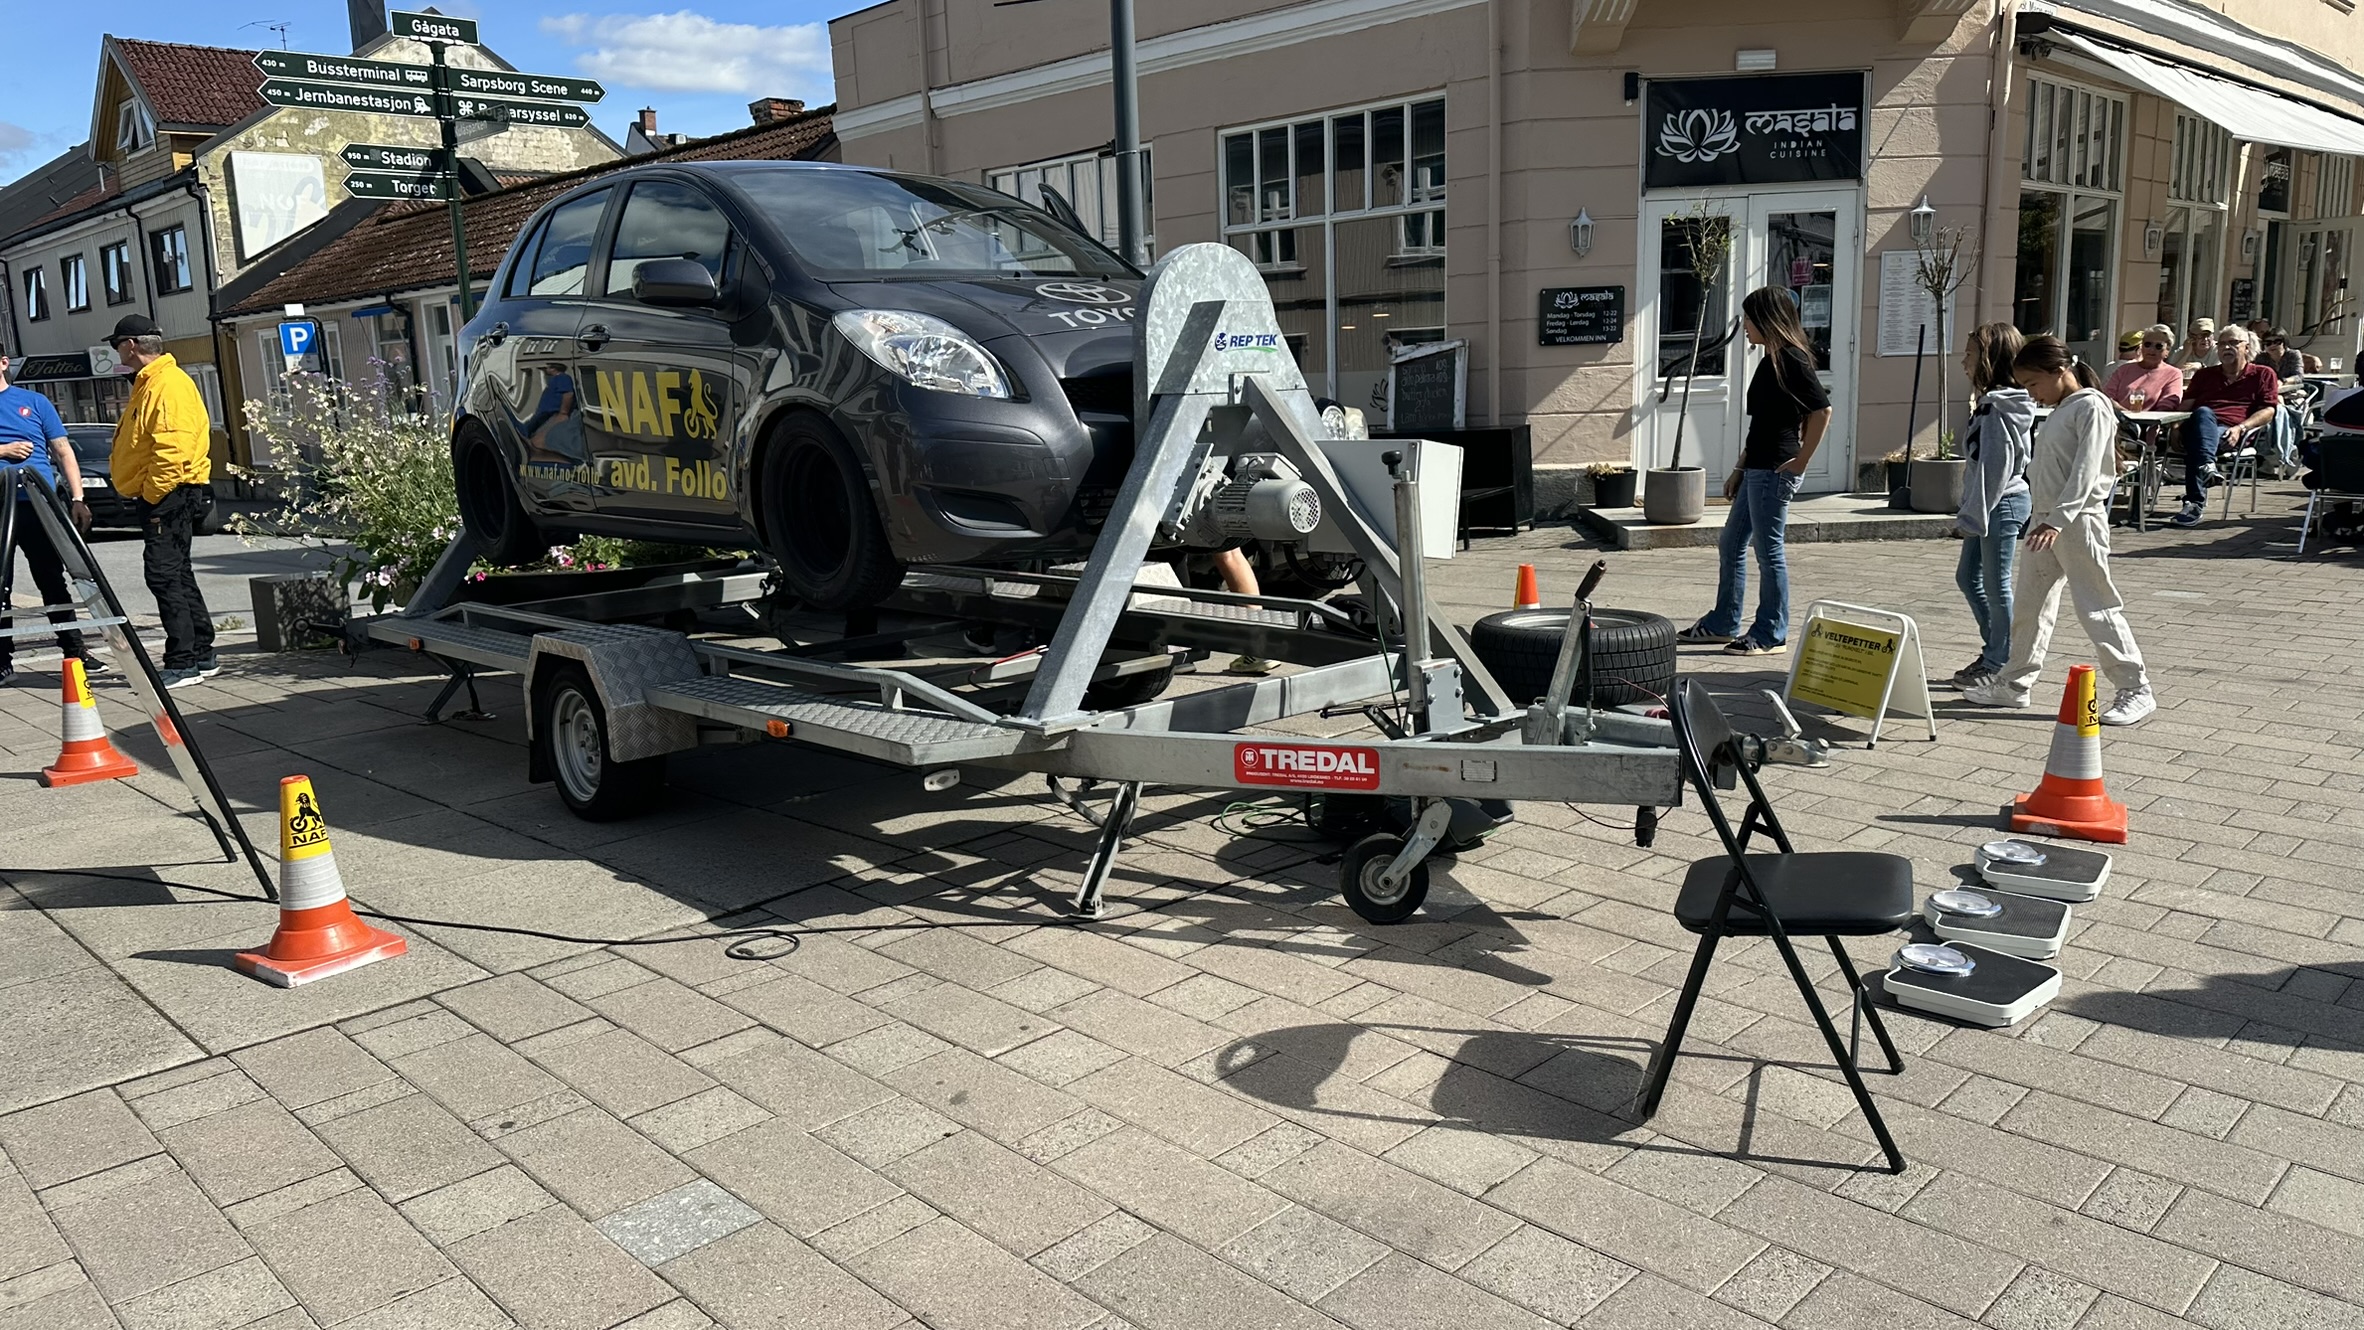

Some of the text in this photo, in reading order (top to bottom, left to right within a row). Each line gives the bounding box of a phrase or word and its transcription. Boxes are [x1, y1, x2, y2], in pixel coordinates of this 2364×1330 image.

[411, 18, 460, 37] Gågata
[261, 58, 277, 68] 430
[306, 60, 401, 81] Bussterminal
[460, 74, 526, 95] Sarpsborg
[531, 80, 568, 96] Scene
[580, 87, 593, 95] 440
[266, 88, 282, 97] 450
[295, 87, 412, 112] Jernbanestasjon
[1744, 102, 1858, 137] masala
[1769, 148, 1827, 159] CUISINE
[1773, 139, 1824, 149] INDIAN
[347, 152, 361, 161] 950
[381, 151, 432, 168] Stadion
[350, 180, 364, 190] 250
[391, 179, 437, 199] Torget
[1580, 290, 1614, 302] masala
[289, 327, 308, 351] P
[1229, 334, 1278, 348] REP TEK
[597, 371, 681, 437] NAF
[610, 454, 727, 500] avd. Follo
[1825, 632, 1881, 650] VELTEPETTER
[1260, 749, 1375, 774] TREDAL
[291, 828, 328, 845] NAF
